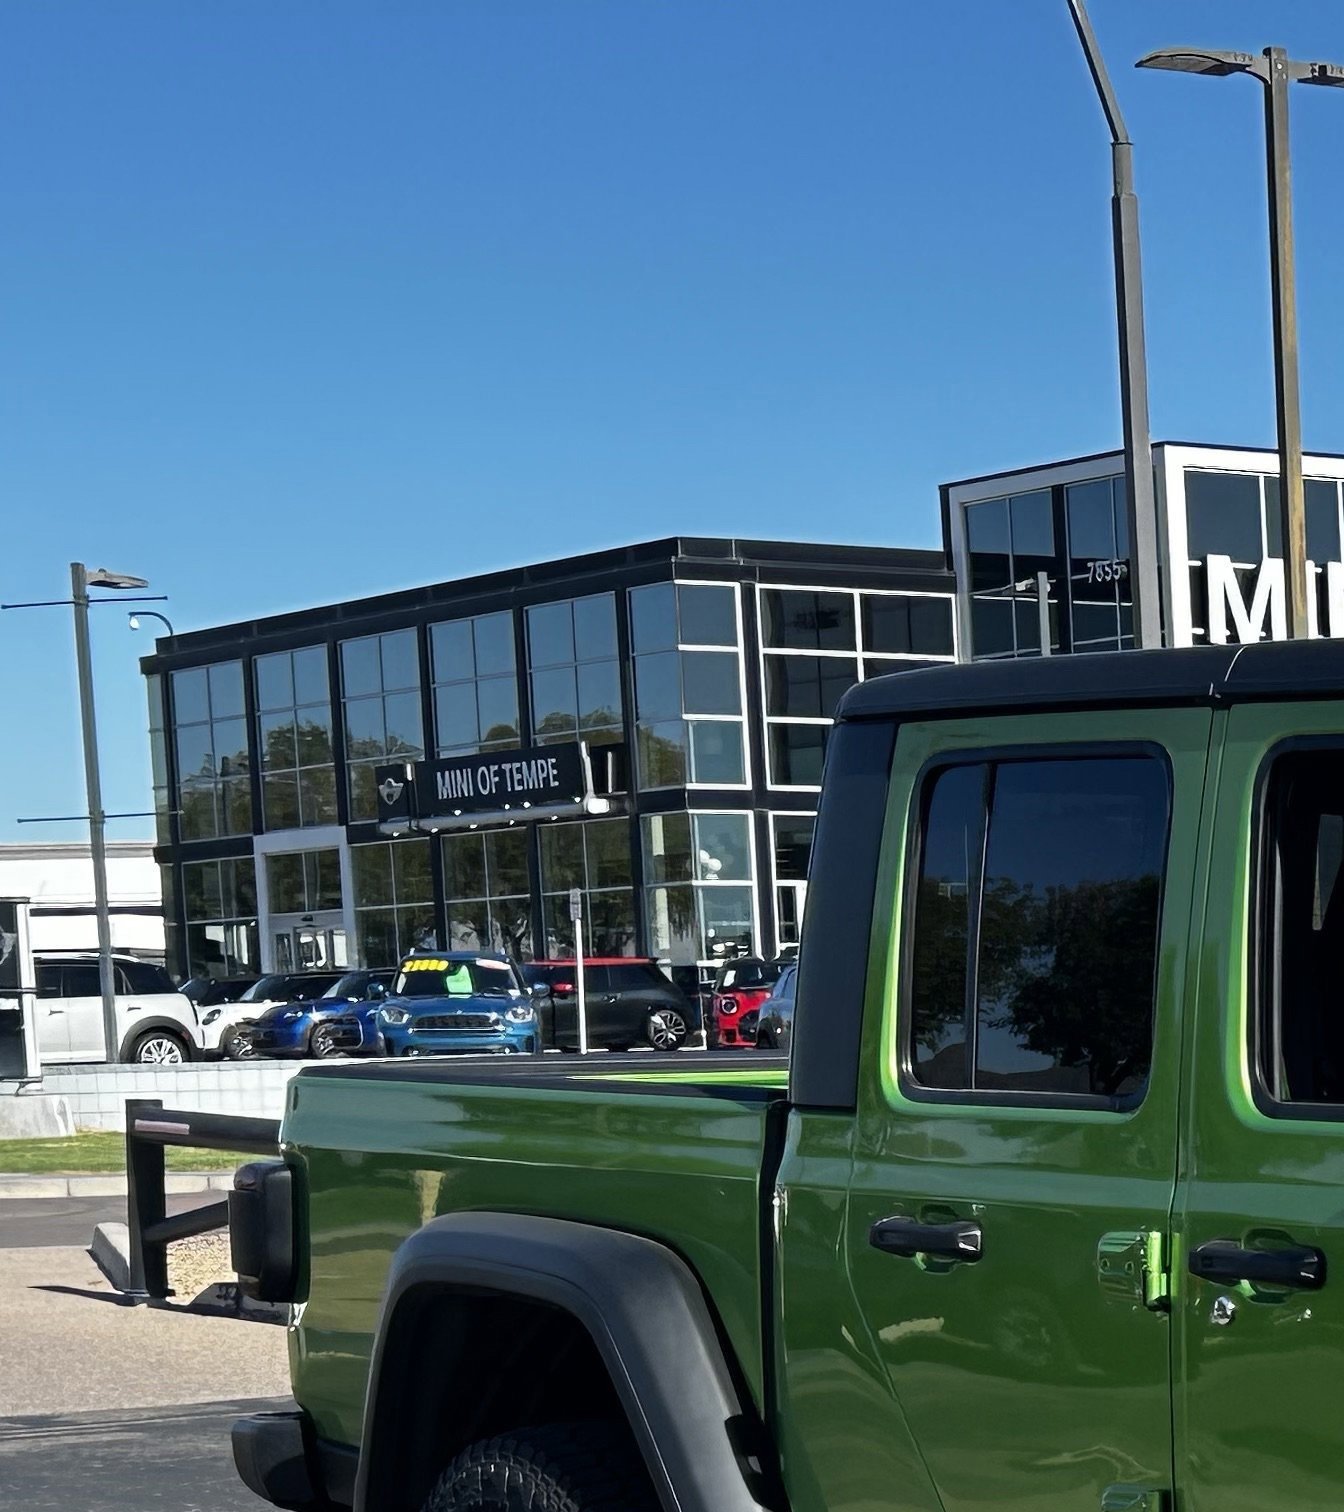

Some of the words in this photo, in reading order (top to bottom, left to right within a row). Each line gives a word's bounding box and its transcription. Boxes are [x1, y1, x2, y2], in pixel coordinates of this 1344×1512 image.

[1087, 559, 1121, 583] 7855
[436, 768, 474, 800] MINI
[477, 764, 500, 796] OF
[501, 758, 559, 792] TEMPE
